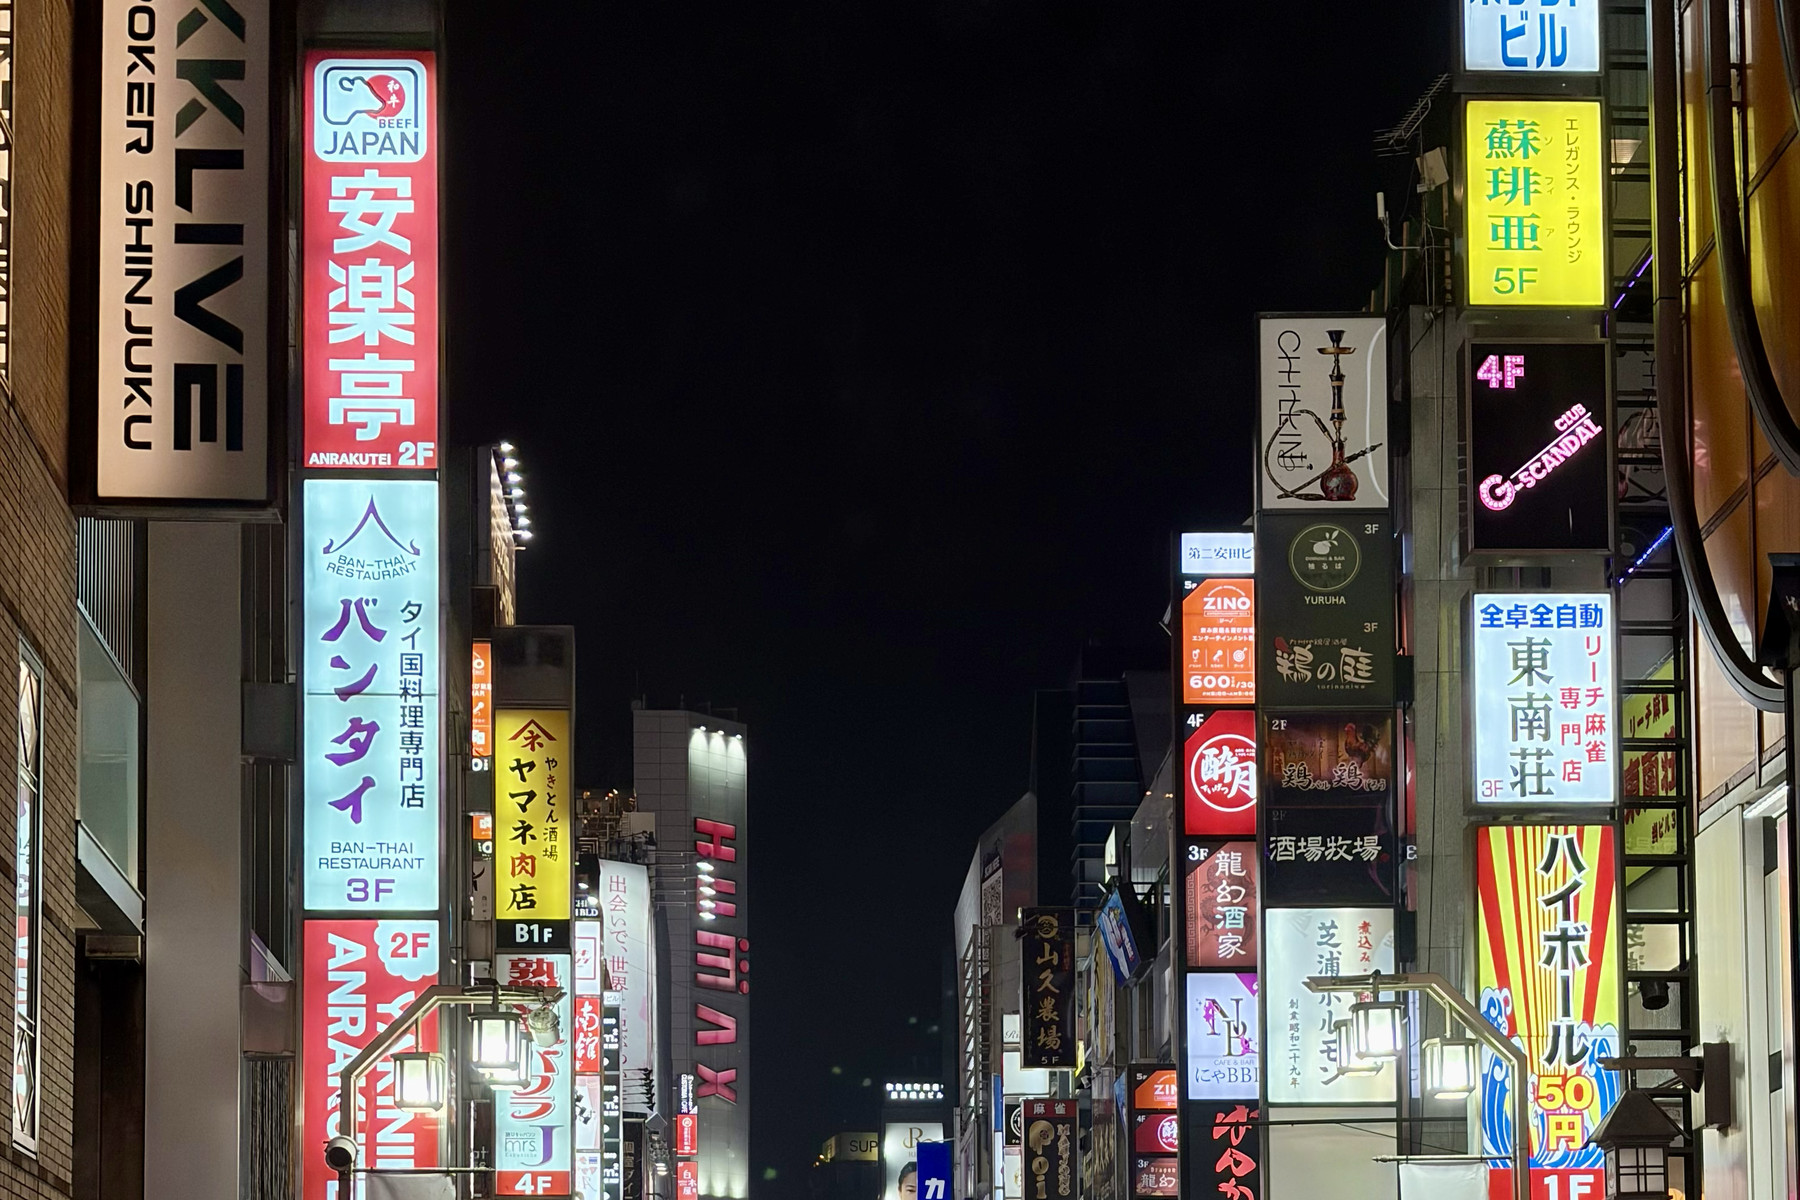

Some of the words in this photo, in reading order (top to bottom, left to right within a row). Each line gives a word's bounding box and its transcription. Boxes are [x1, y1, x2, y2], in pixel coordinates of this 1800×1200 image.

[1500, 13, 1568, 69] ビル
[126, 0, 155, 154] OKER
[378, 118, 413, 129] BEEF
[323, 131, 419, 156] JAPAN
[1485, 119, 1543, 252] 蘇琲亜
[1565, 117, 1583, 264] エレガンス・ラウンジ
[1493, 267, 1538, 295] 5F
[123, 180, 154, 450] SHINJUKU
[328, 169, 415, 441] 安楽亭
[1477, 355, 1525, 389] 4F
[1554, 403, 1586, 432] CLUB
[308, 452, 392, 466] ANRAKUTEI
[398, 442, 435, 466] 2F
[1364, 524, 1379, 534] 3F
[327, 561, 418, 581] RESTAURANT
[337, 555, 405, 569] BAN-THAI
[1184, 581, 1197, 590] 5F
[1203, 597, 1250, 610] ZINO
[1304, 596, 1346, 605] YURUHA
[1364, 623, 1378, 633] 3F
[1479, 603, 1604, 629] 全卓全自動
[1275, 645, 1377, 684] 鶏の庭
[1190, 675, 1230, 689] 600
[321, 597, 388, 825] バンタイ
[400, 600, 425, 809] タイ国料理専門店
[1585, 635, 1607, 763] リーチ麻雀
[1187, 713, 1204, 728] 4F
[1272, 720, 1288, 731] 2F
[1507, 636, 1555, 797] 東南荘
[1560, 687, 1582, 783] 専門店
[1201, 745, 1256, 799] 酔月
[1482, 780, 1503, 798] 3F
[543, 757, 559, 862] やきとん酒場
[508, 757, 538, 911] ヤマネ肉店
[331, 842, 414, 854] BAN-THAI
[1188, 845, 1209, 861] 3F
[1269, 835, 1382, 862] 酒場牧場
[318, 857, 425, 870] RESTAURANT
[346, 878, 396, 903] 3F
[1215, 850, 1247, 960] 龍幻酒家
[390, 932, 430, 958] 2F
[515, 923, 553, 943] B1F
[1536, 833, 1592, 1069] ハイボール
[1036, 943, 1062, 1050] 山久農場
[1288, 998, 1301, 1090] 創業昭和二十九年
[1041, 1056, 1060, 1064] 5F
[1154, 1084, 1178, 1095] ZIN
[1538, 1074, 1594, 1112] 50
[1033, 1103, 1066, 1115] 麻雀
[1136, 1114, 1146, 1122] 4F
[1545, 1112, 1587, 1152] 円
[849, 1140, 878, 1153] SUP
[1138, 1159, 1149, 1168] 3F
[515, 1173, 552, 1195] 4F
